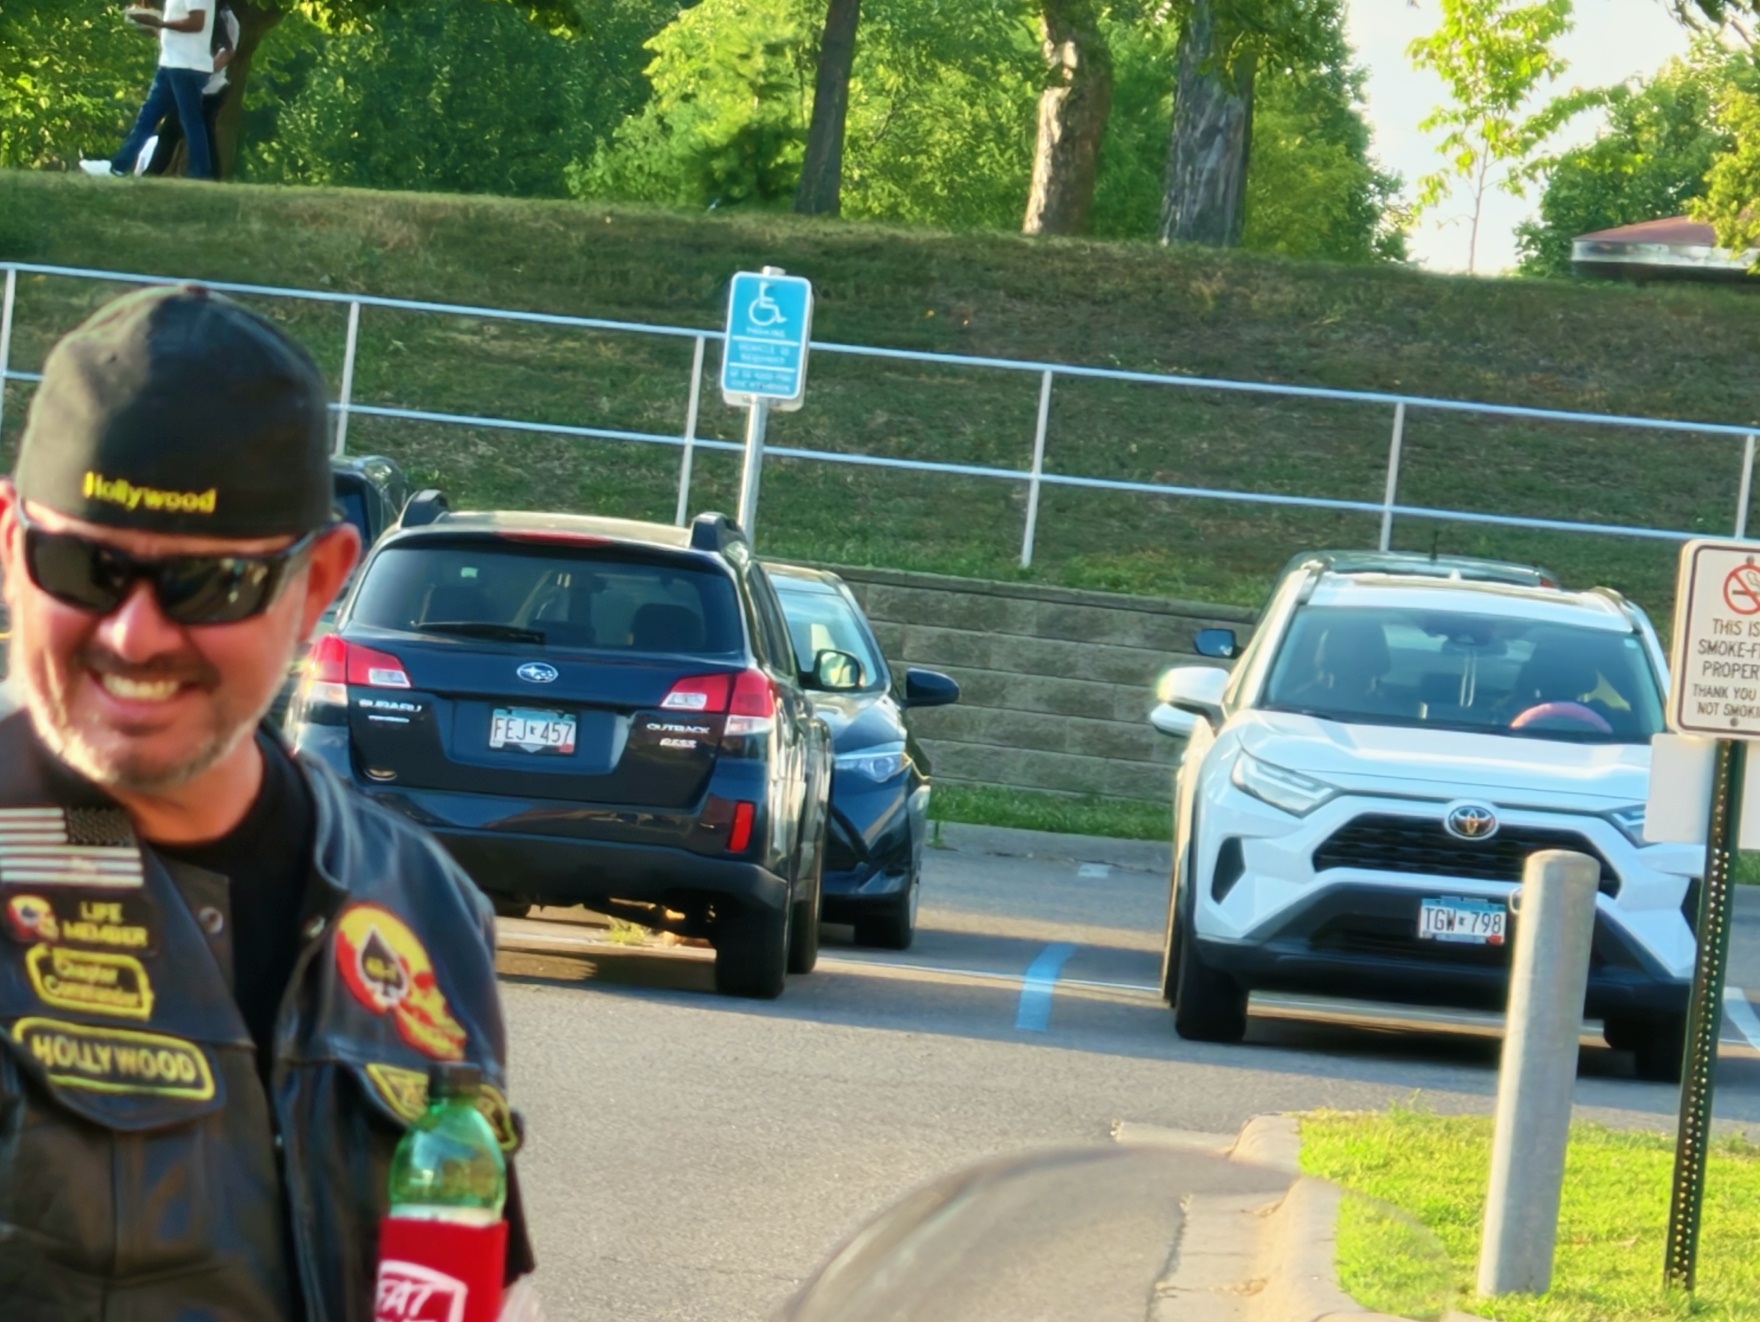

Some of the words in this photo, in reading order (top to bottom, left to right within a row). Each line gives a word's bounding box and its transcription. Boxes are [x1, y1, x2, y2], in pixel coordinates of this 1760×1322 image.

[1712, 617, 1744, 636] THIS
[1698, 638, 1760, 660] SMOKE-F
[1702, 660, 1760, 680] PROPER
[1692, 683, 1729, 700] THANK
[1733, 686, 1757, 702] YOU
[1697, 701, 1720, 717] NOT
[1723, 703, 1760, 720] SMOKI
[494, 717, 527, 741] FEJ
[540, 722, 573, 745] 457
[646, 722, 711, 735] OUTBACK
[80, 901, 123, 923] LIFE
[1425, 907, 1457, 932] TGW
[1470, 912, 1502, 934] 798
[63, 920, 148, 947] MEMBER
[32, 1033, 197, 1083] HOLLYWOOD
